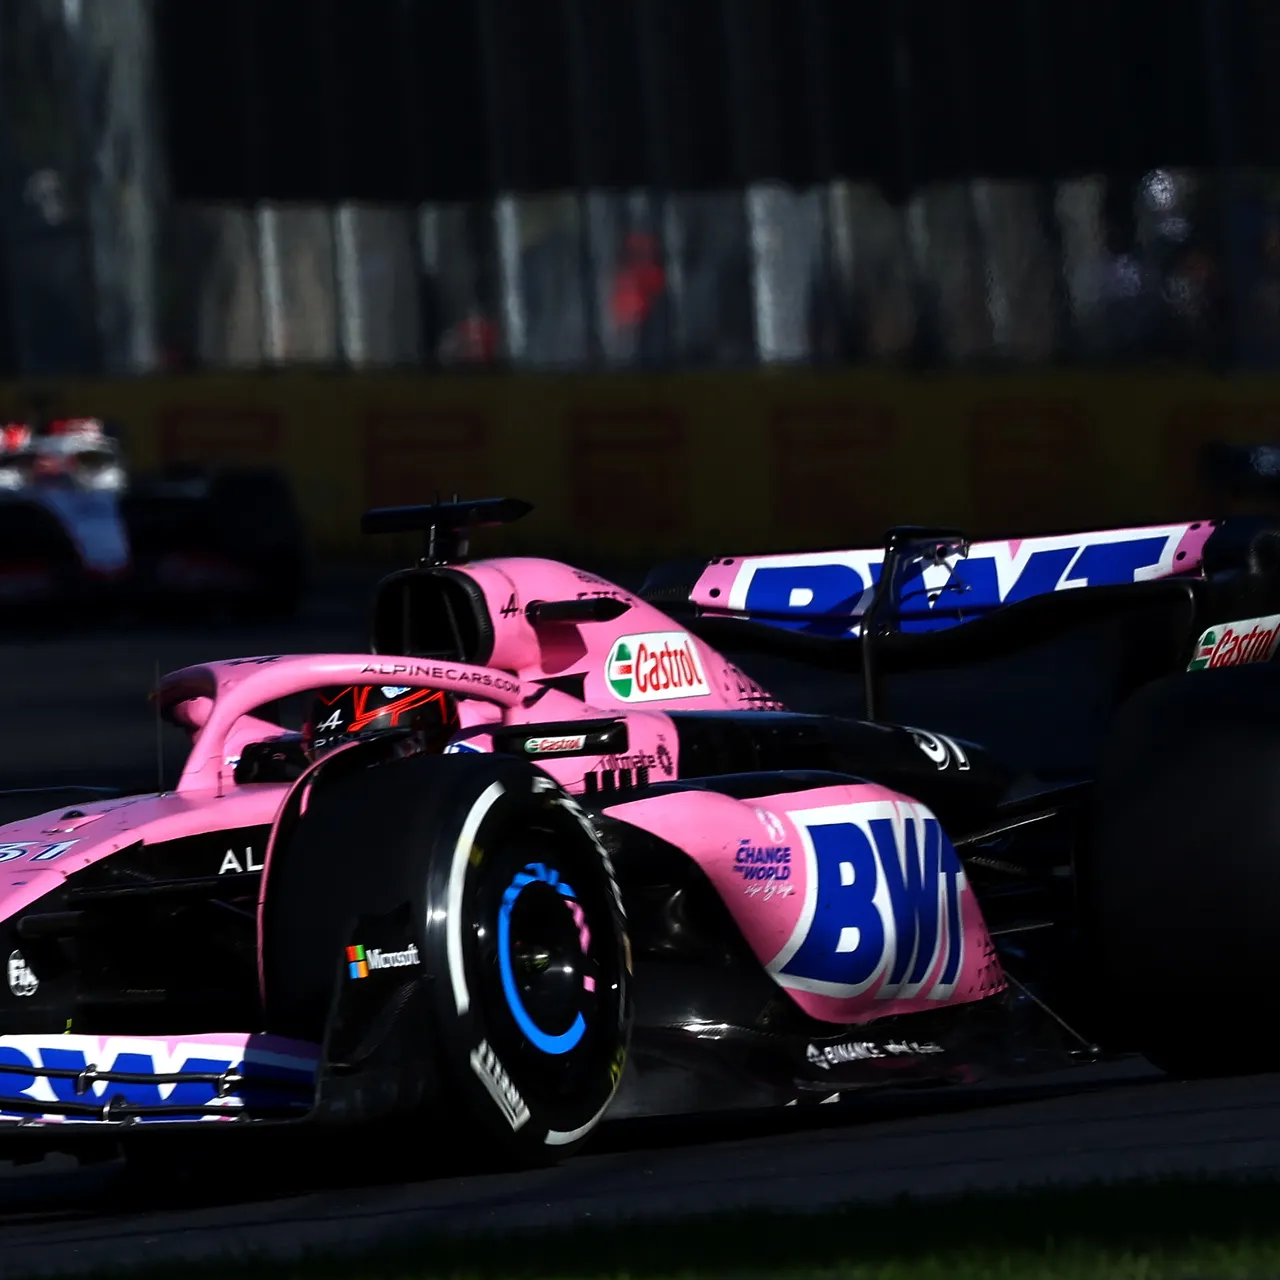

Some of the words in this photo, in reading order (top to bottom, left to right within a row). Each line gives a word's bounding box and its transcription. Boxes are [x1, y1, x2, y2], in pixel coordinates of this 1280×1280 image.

[634, 635, 703, 693] Castrol
[361, 663, 520, 694] ALPINECARS.COM
[539, 737, 581, 751] Castrol
[735, 847, 791, 864] CHANGE
[743, 865, 792, 880] WORLD
[779, 817, 964, 986] BWT
[366, 943, 421, 970] Microsoft
